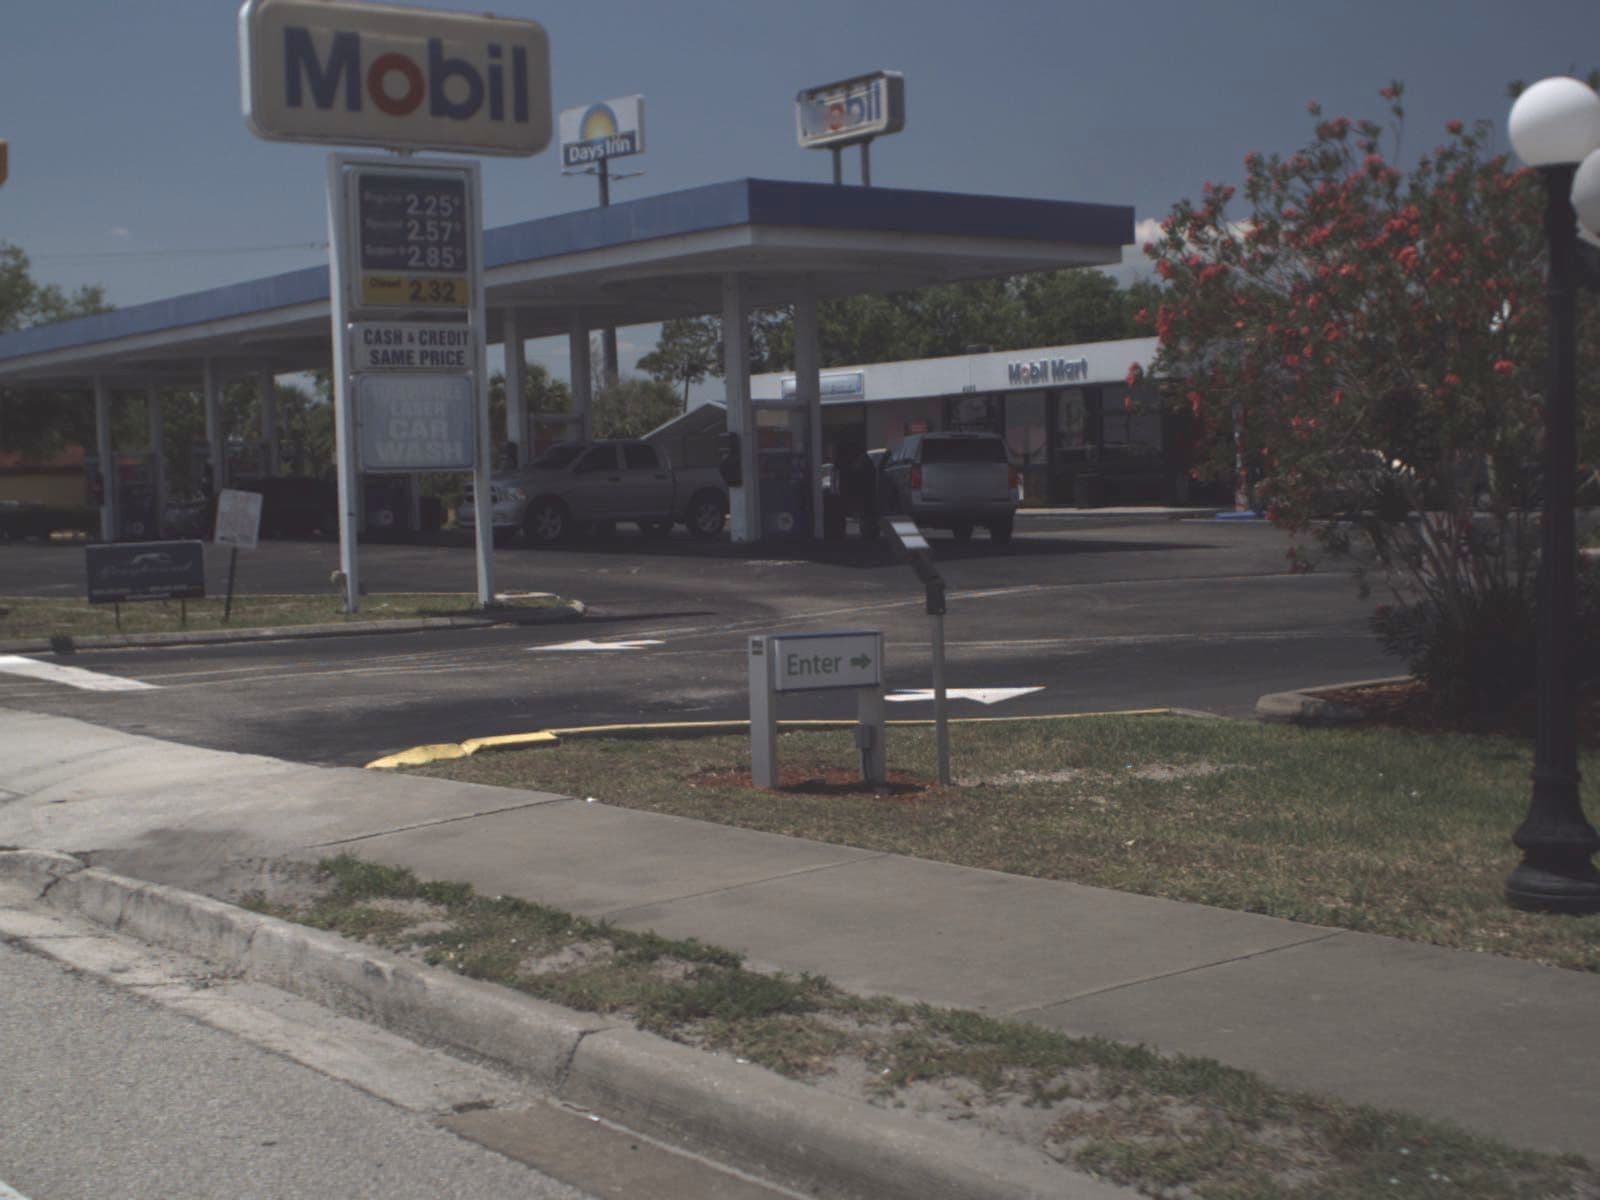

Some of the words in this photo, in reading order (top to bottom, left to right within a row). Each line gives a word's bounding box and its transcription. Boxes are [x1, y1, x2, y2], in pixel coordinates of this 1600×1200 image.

[284, 26, 528, 122] Mobil
[569, 143, 604, 161] Days
[604, 138, 631, 155] Inn
[364, 329, 402, 345] CASH
[418, 330, 469, 346] CREDIT
[370, 349, 417, 365] SAME
[419, 350, 465, 366] PRICE
[1008, 360, 1048, 384] Mobil
[1051, 357, 1088, 383] Mart
[389, 418, 448, 440] CAR
[376, 440, 463, 463] WASH
[786, 653, 842, 677] Enter
